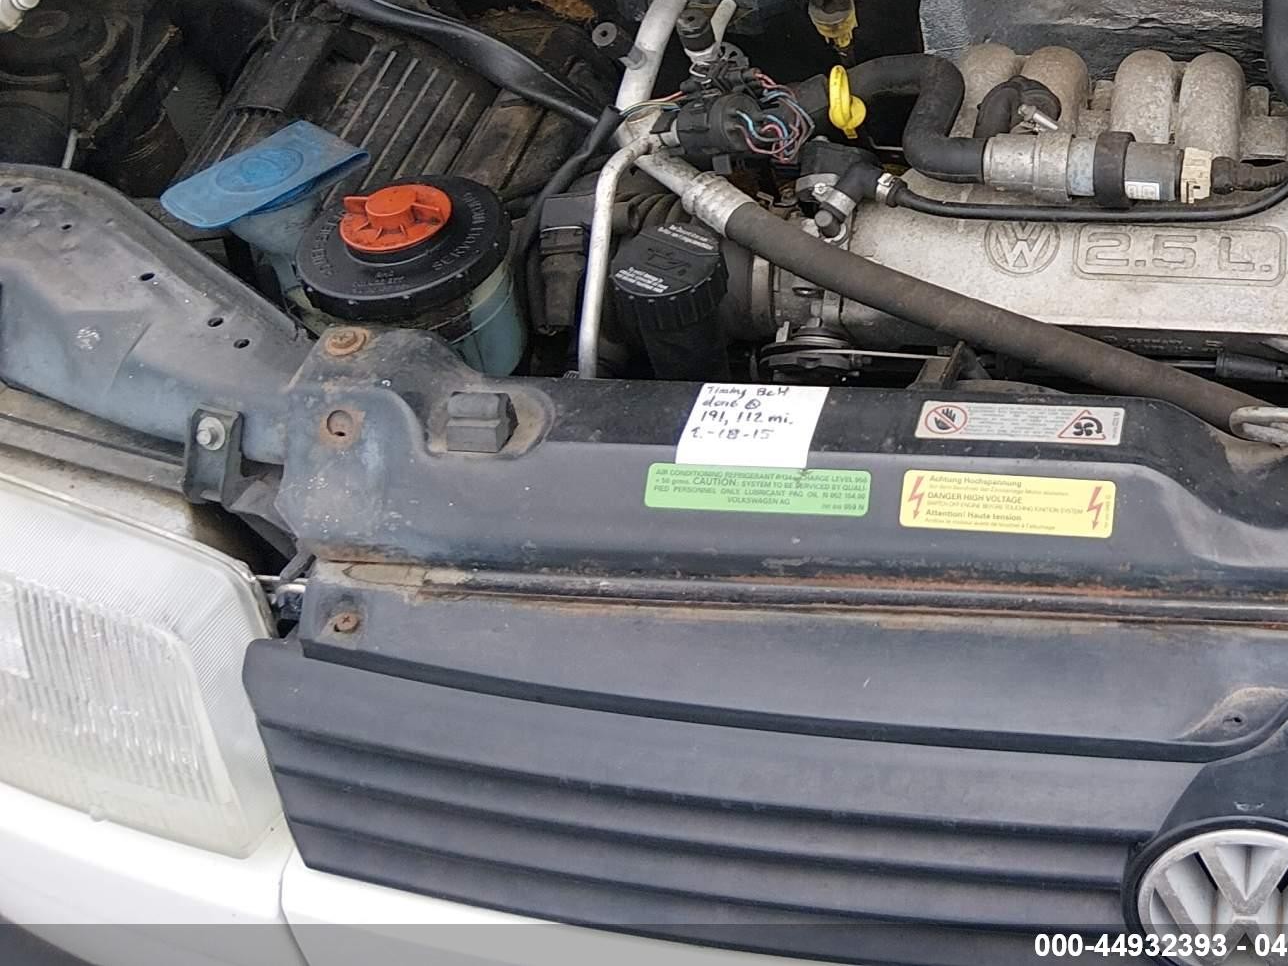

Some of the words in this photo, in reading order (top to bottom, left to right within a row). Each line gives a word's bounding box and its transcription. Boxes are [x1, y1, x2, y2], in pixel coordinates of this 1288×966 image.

[1085, 232, 1197, 270] 2.5
[741, 480, 771, 488] SYSTEM
[929, 475, 962, 485] Achtung
[964, 477, 1022, 488] Hochspannung
[727, 496, 778, 505] VOLKSWAGEN
[927, 492, 962, 500] DANGER
[986, 495, 1022, 504] VOLTAGE
[968, 511, 990, 519] Haute
[992, 513, 1022, 521] tension
